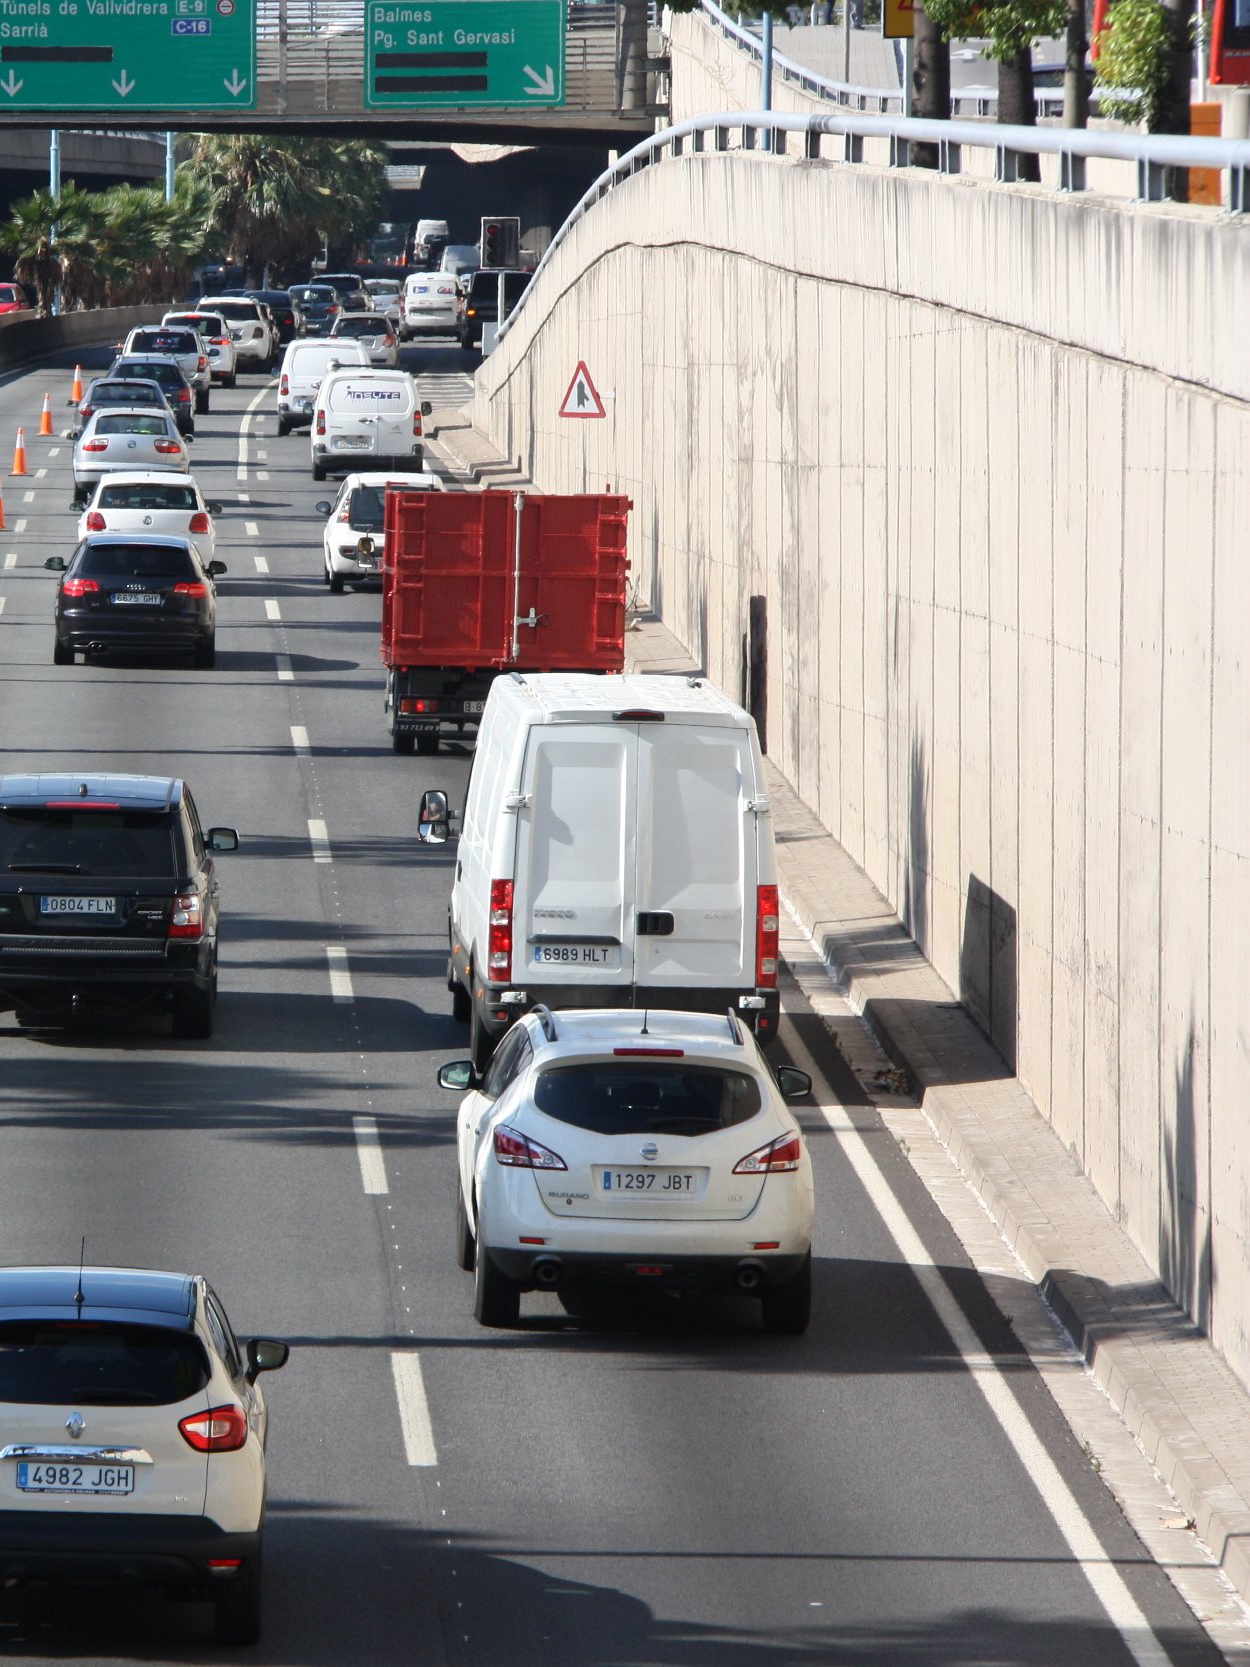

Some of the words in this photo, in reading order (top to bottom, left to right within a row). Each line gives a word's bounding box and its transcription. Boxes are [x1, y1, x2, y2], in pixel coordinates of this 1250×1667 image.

[0, 0, 51, 15] Túnels
[58, 0, 78, 15] de
[86, 0, 168, 15] Vallvidrera
[179, 0, 203, 12] E-9
[374, 7, 432, 22] Balmes
[0, 22, 48, 38] Sarrià
[175, 21, 207, 33] C-16
[374, 30, 397, 48] Pg.
[407, 30, 444, 45] Sant
[454, 28, 515, 44] Gervasi
[50, 899, 83, 911] 0804
[88, 899, 113, 912] FLN
[544, 948, 578, 961] 6989
[583, 948, 609, 962] HLT
[616, 1173, 656, 1189] 1297
[662, 1175, 692, 1190] JBT
[32, 1466, 83, 1486] 4982
[91, 1469, 129, 1488] JGH
